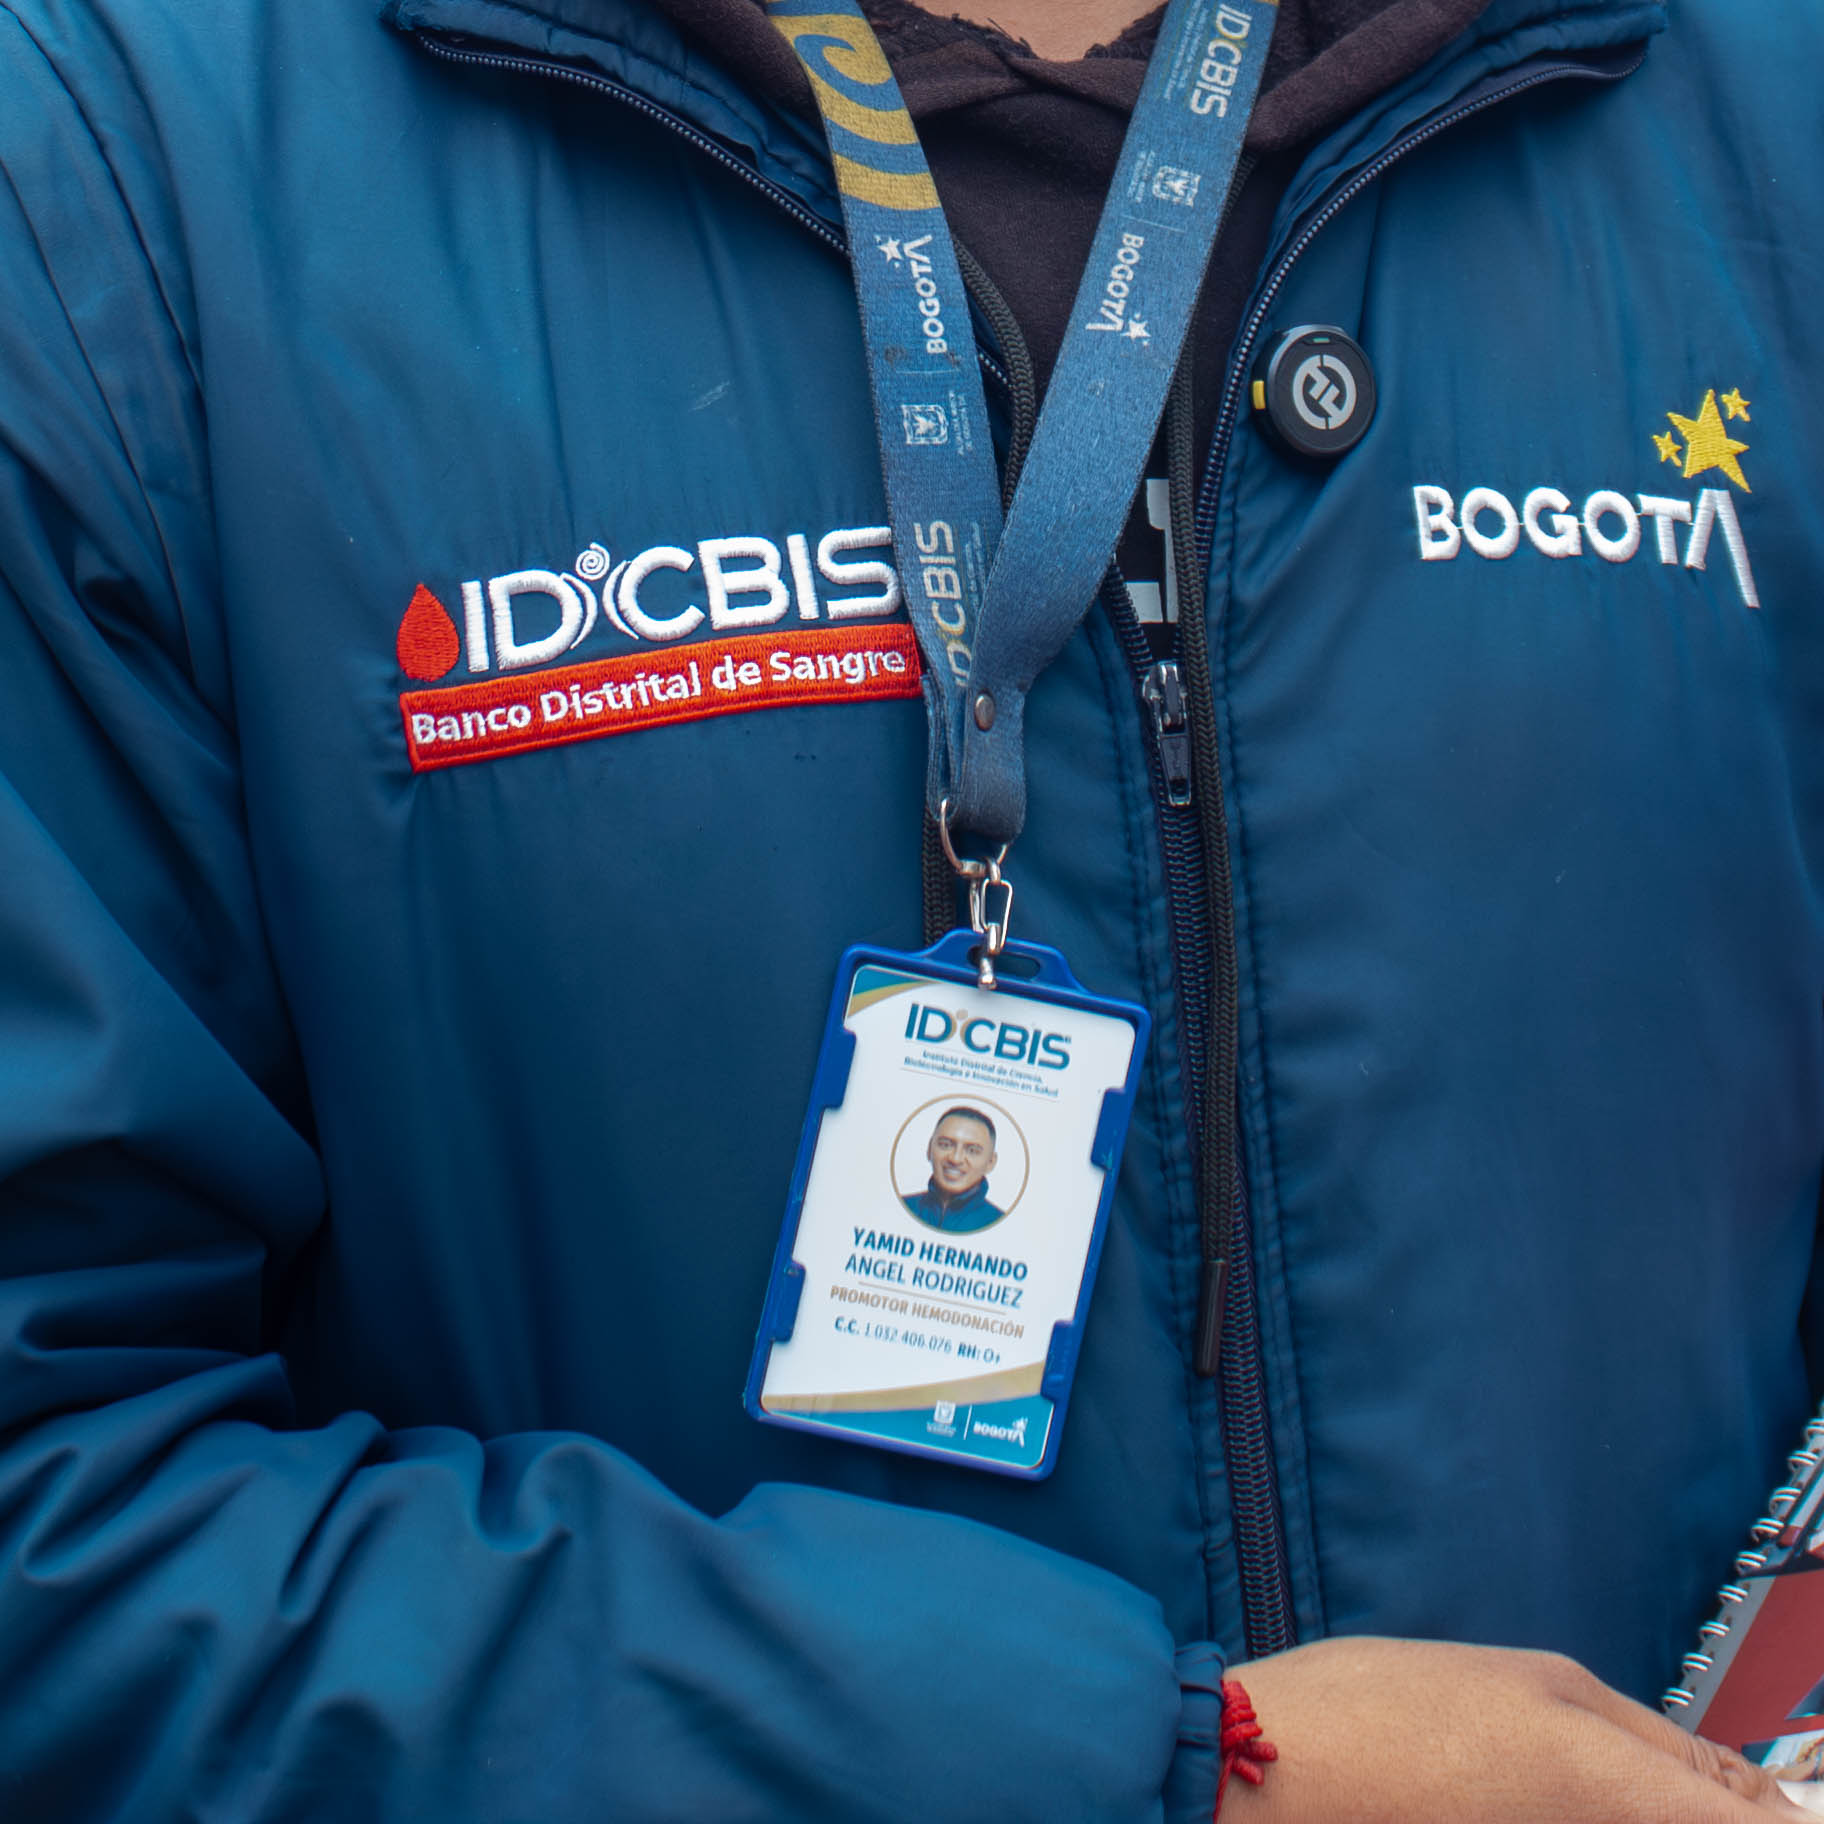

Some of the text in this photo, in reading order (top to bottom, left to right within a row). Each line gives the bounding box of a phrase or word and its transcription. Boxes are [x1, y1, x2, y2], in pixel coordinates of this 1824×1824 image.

[411, 650, 906, 745] Banco Distrital de Sangre
[845, 1253, 1024, 1309] ANGEL RODRIGUEZ
[853, 1225, 1028, 1282] YAMID HERNANDO
[830, 1284, 1025, 1339] PROMOTOR HEMODONACIÓN
[834, 1315, 860, 1335] C.C.
